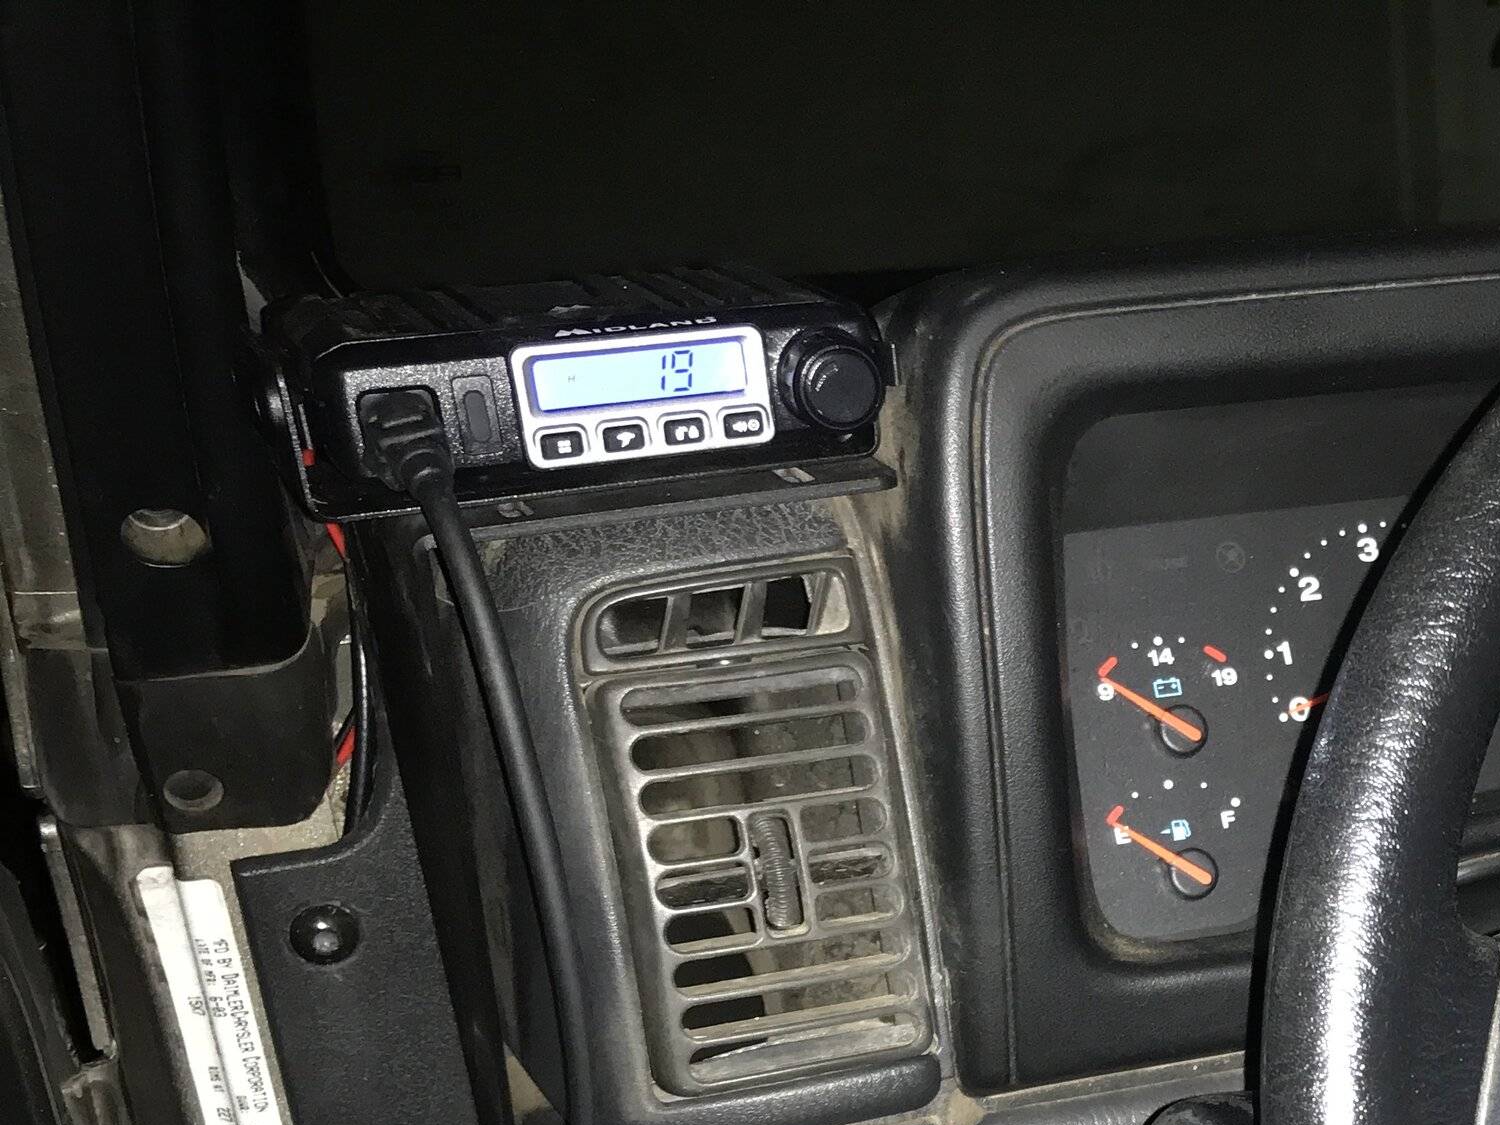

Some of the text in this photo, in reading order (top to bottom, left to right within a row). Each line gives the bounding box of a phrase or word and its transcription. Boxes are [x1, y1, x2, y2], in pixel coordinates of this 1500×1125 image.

[554, 316, 718, 338] MIDLAND
[661, 350, 693, 392] 19
[1357, 537, 1379, 562] 3
[1298, 576, 1322, 601] 2
[1148, 648, 1175, 666] 14
[1276, 641, 1292, 665] 1
[1211, 668, 1237, 686] 19
[1097, 682, 1115, 701] 9
[1220, 810, 1235, 829] F
